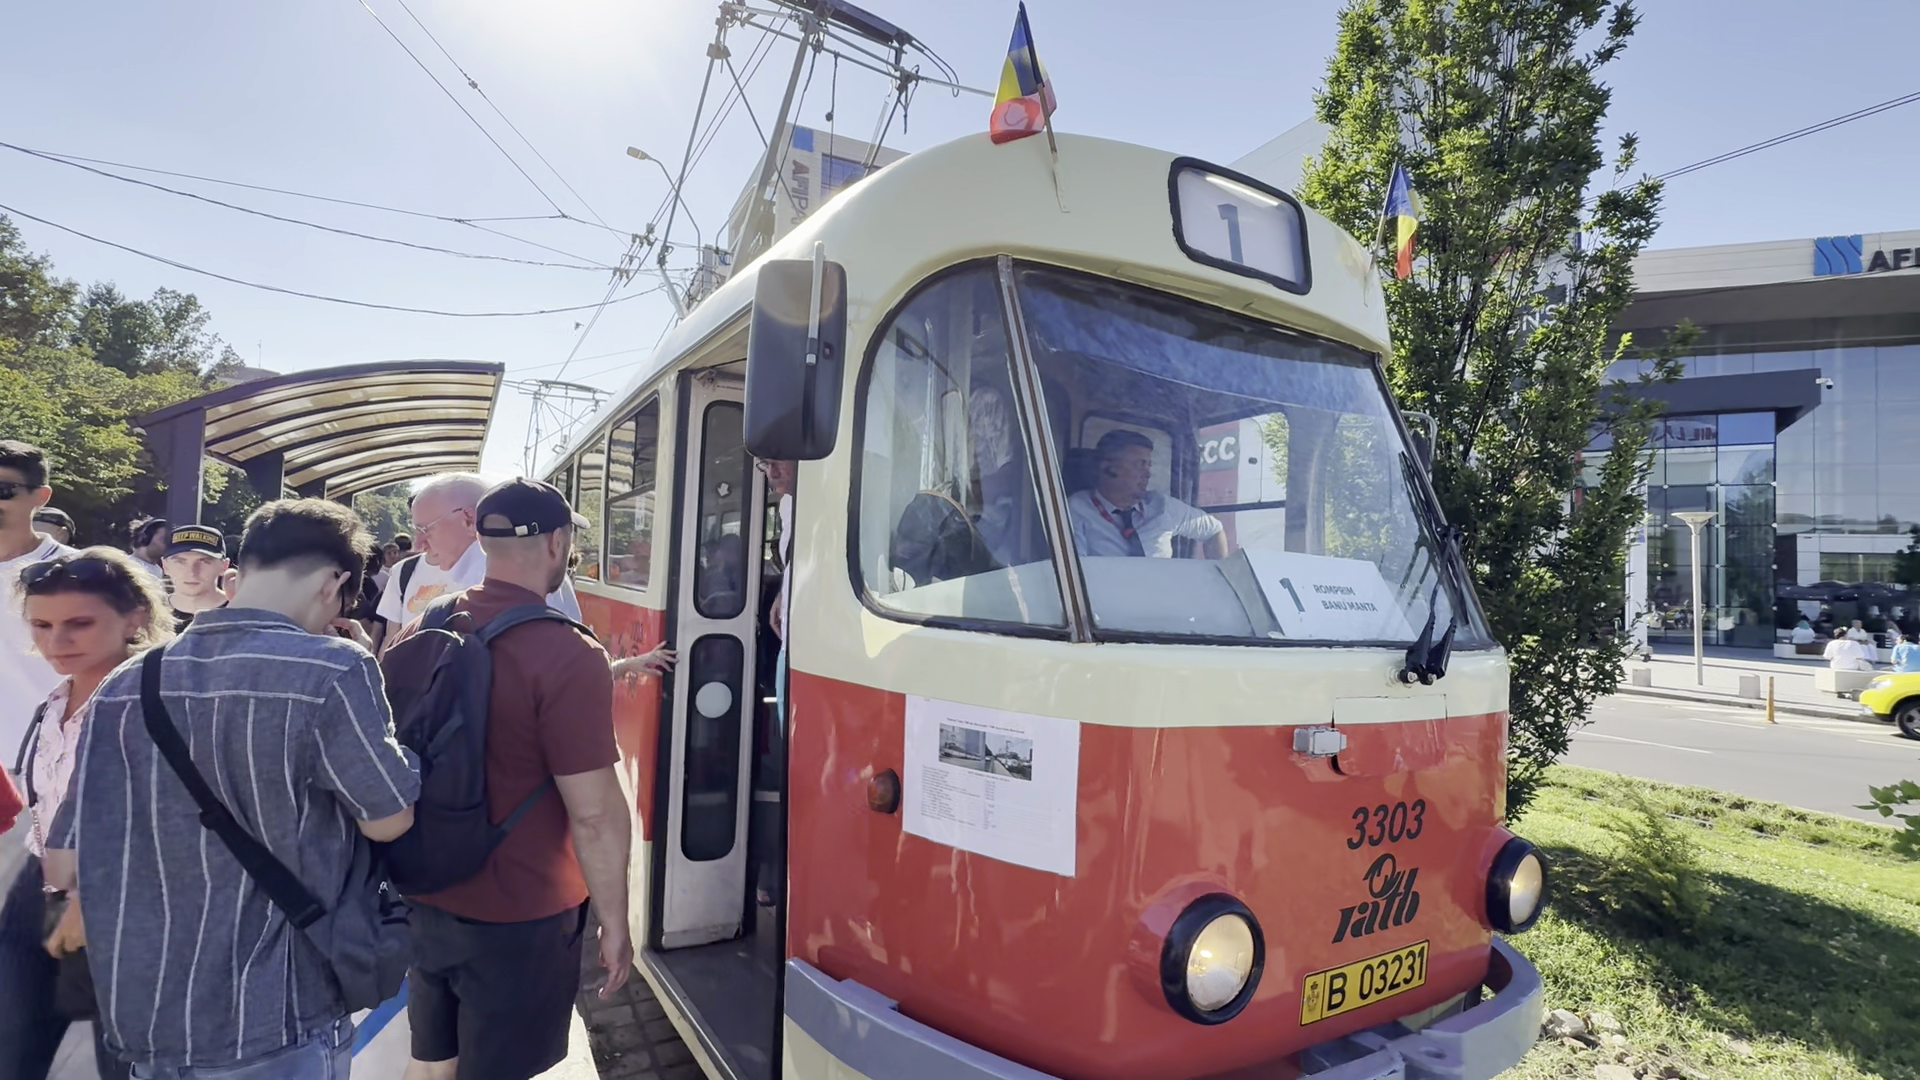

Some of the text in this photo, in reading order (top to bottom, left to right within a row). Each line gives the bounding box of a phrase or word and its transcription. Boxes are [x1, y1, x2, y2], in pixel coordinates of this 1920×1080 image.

[1217, 203, 1244, 265] 1
[1199, 436, 1236, 465] CC
[1279, 577, 1305, 612] 1
[1313, 584, 1356, 596] ROMPRIM
[1321, 600, 1378, 612] BANU MANTA
[1347, 799, 1426, 850] 3303
[1327, 946, 1426, 1012] B 03231
